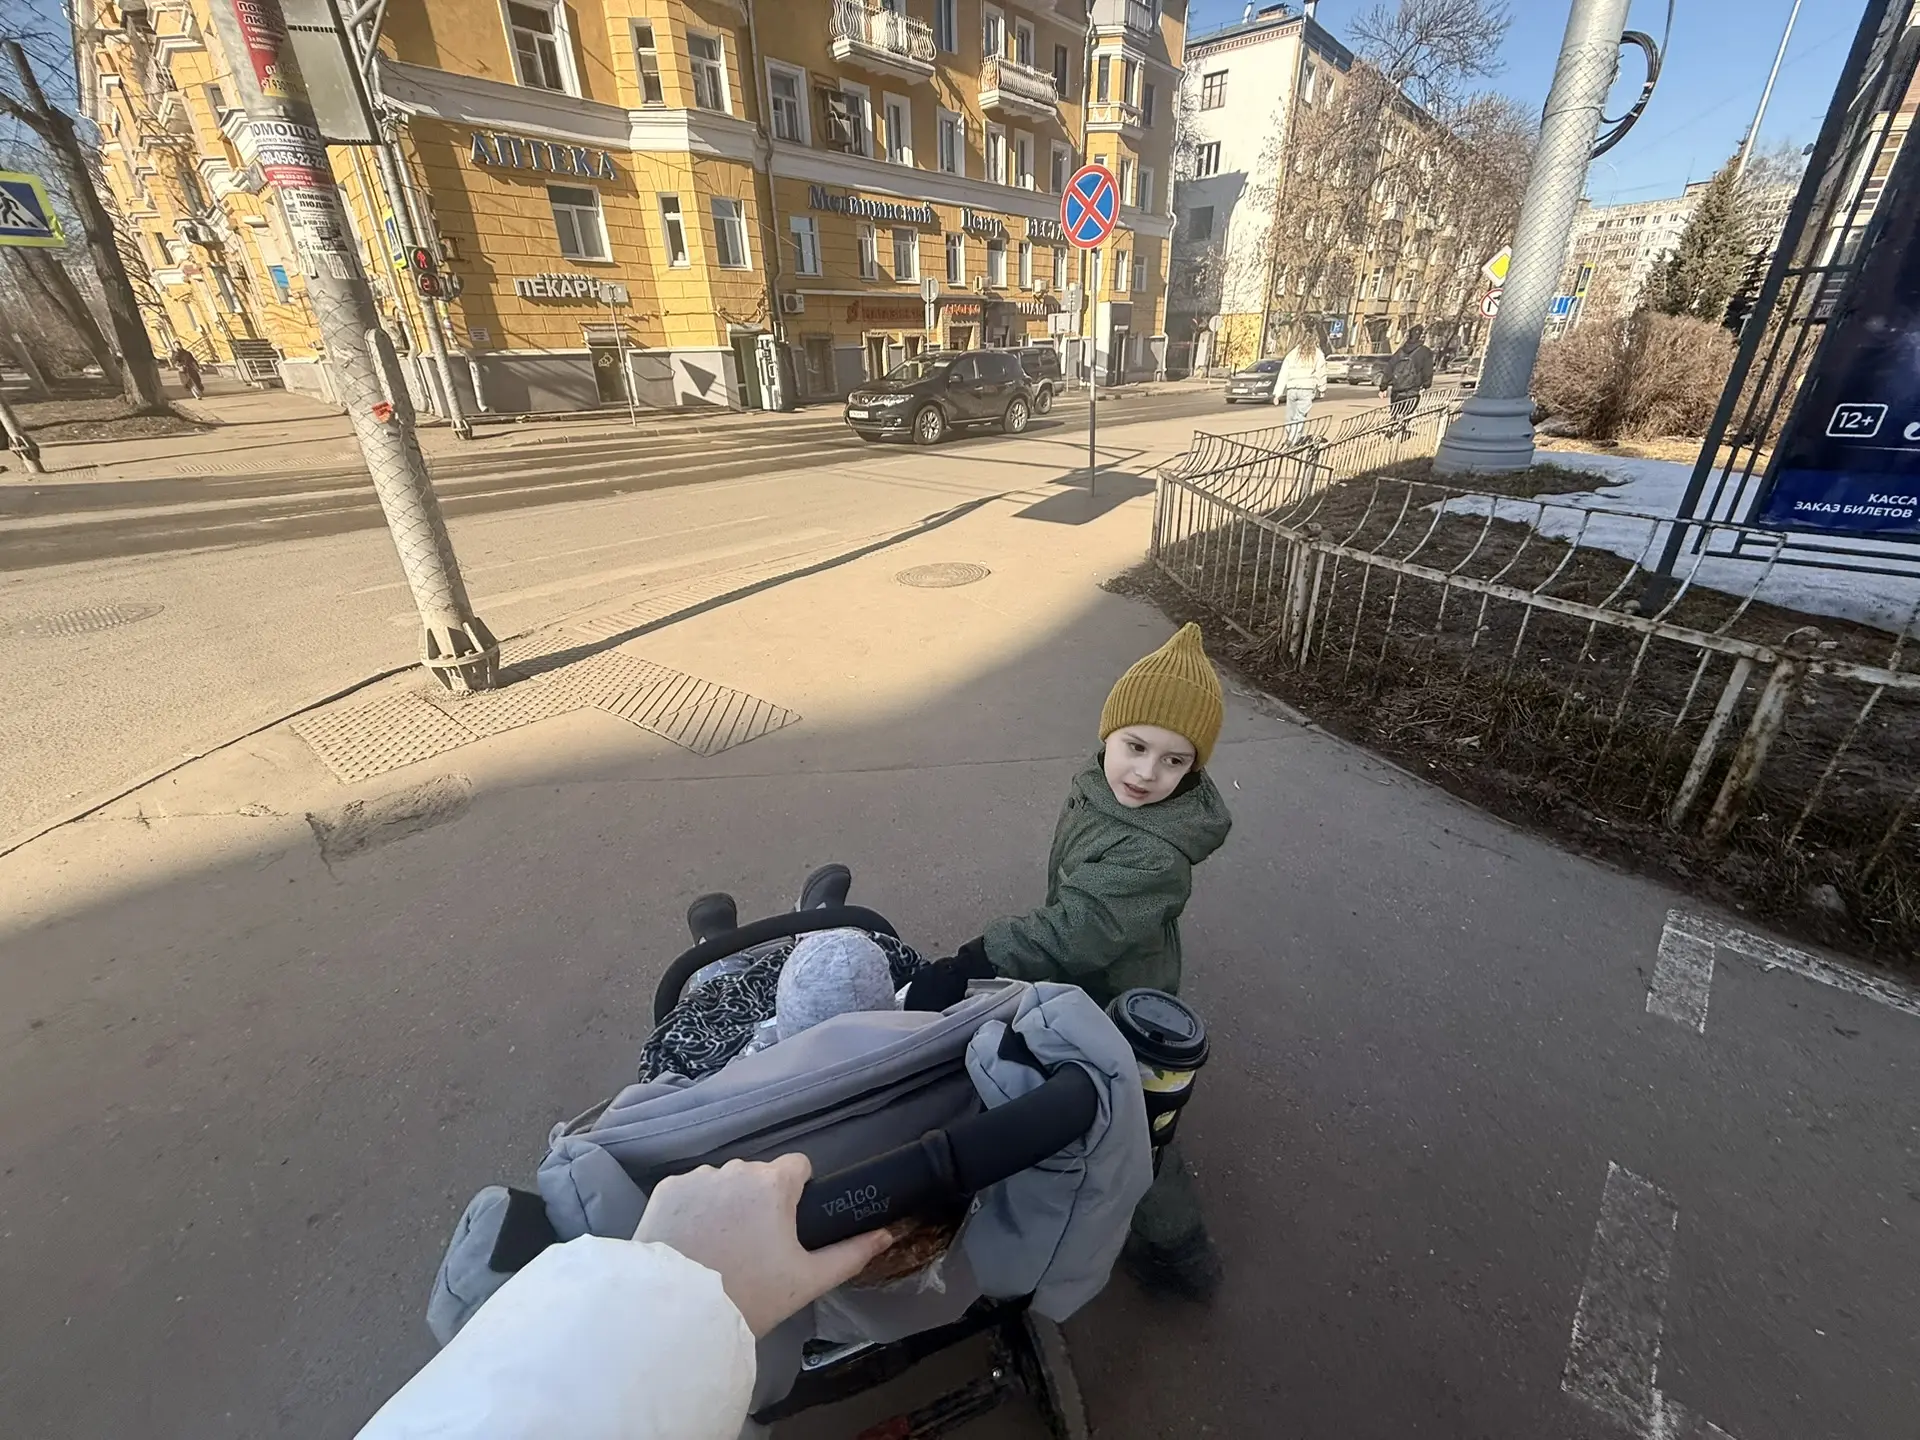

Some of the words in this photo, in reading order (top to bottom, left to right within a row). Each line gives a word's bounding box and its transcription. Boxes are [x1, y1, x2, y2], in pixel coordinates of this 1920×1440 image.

[468, 132, 617, 181] АПТЕКА
[513, 277, 602, 299] ПЕКАРН
[1838, 411, 1874, 429] 12+
[1794, 501, 1841, 513] ЗАКАЗ
[1843, 504, 1914, 518] БИЛЕТОВ
[1868, 493, 1918, 506] КАССА
[821, 1184, 877, 1217] valco
[852, 1196, 891, 1222] baby
